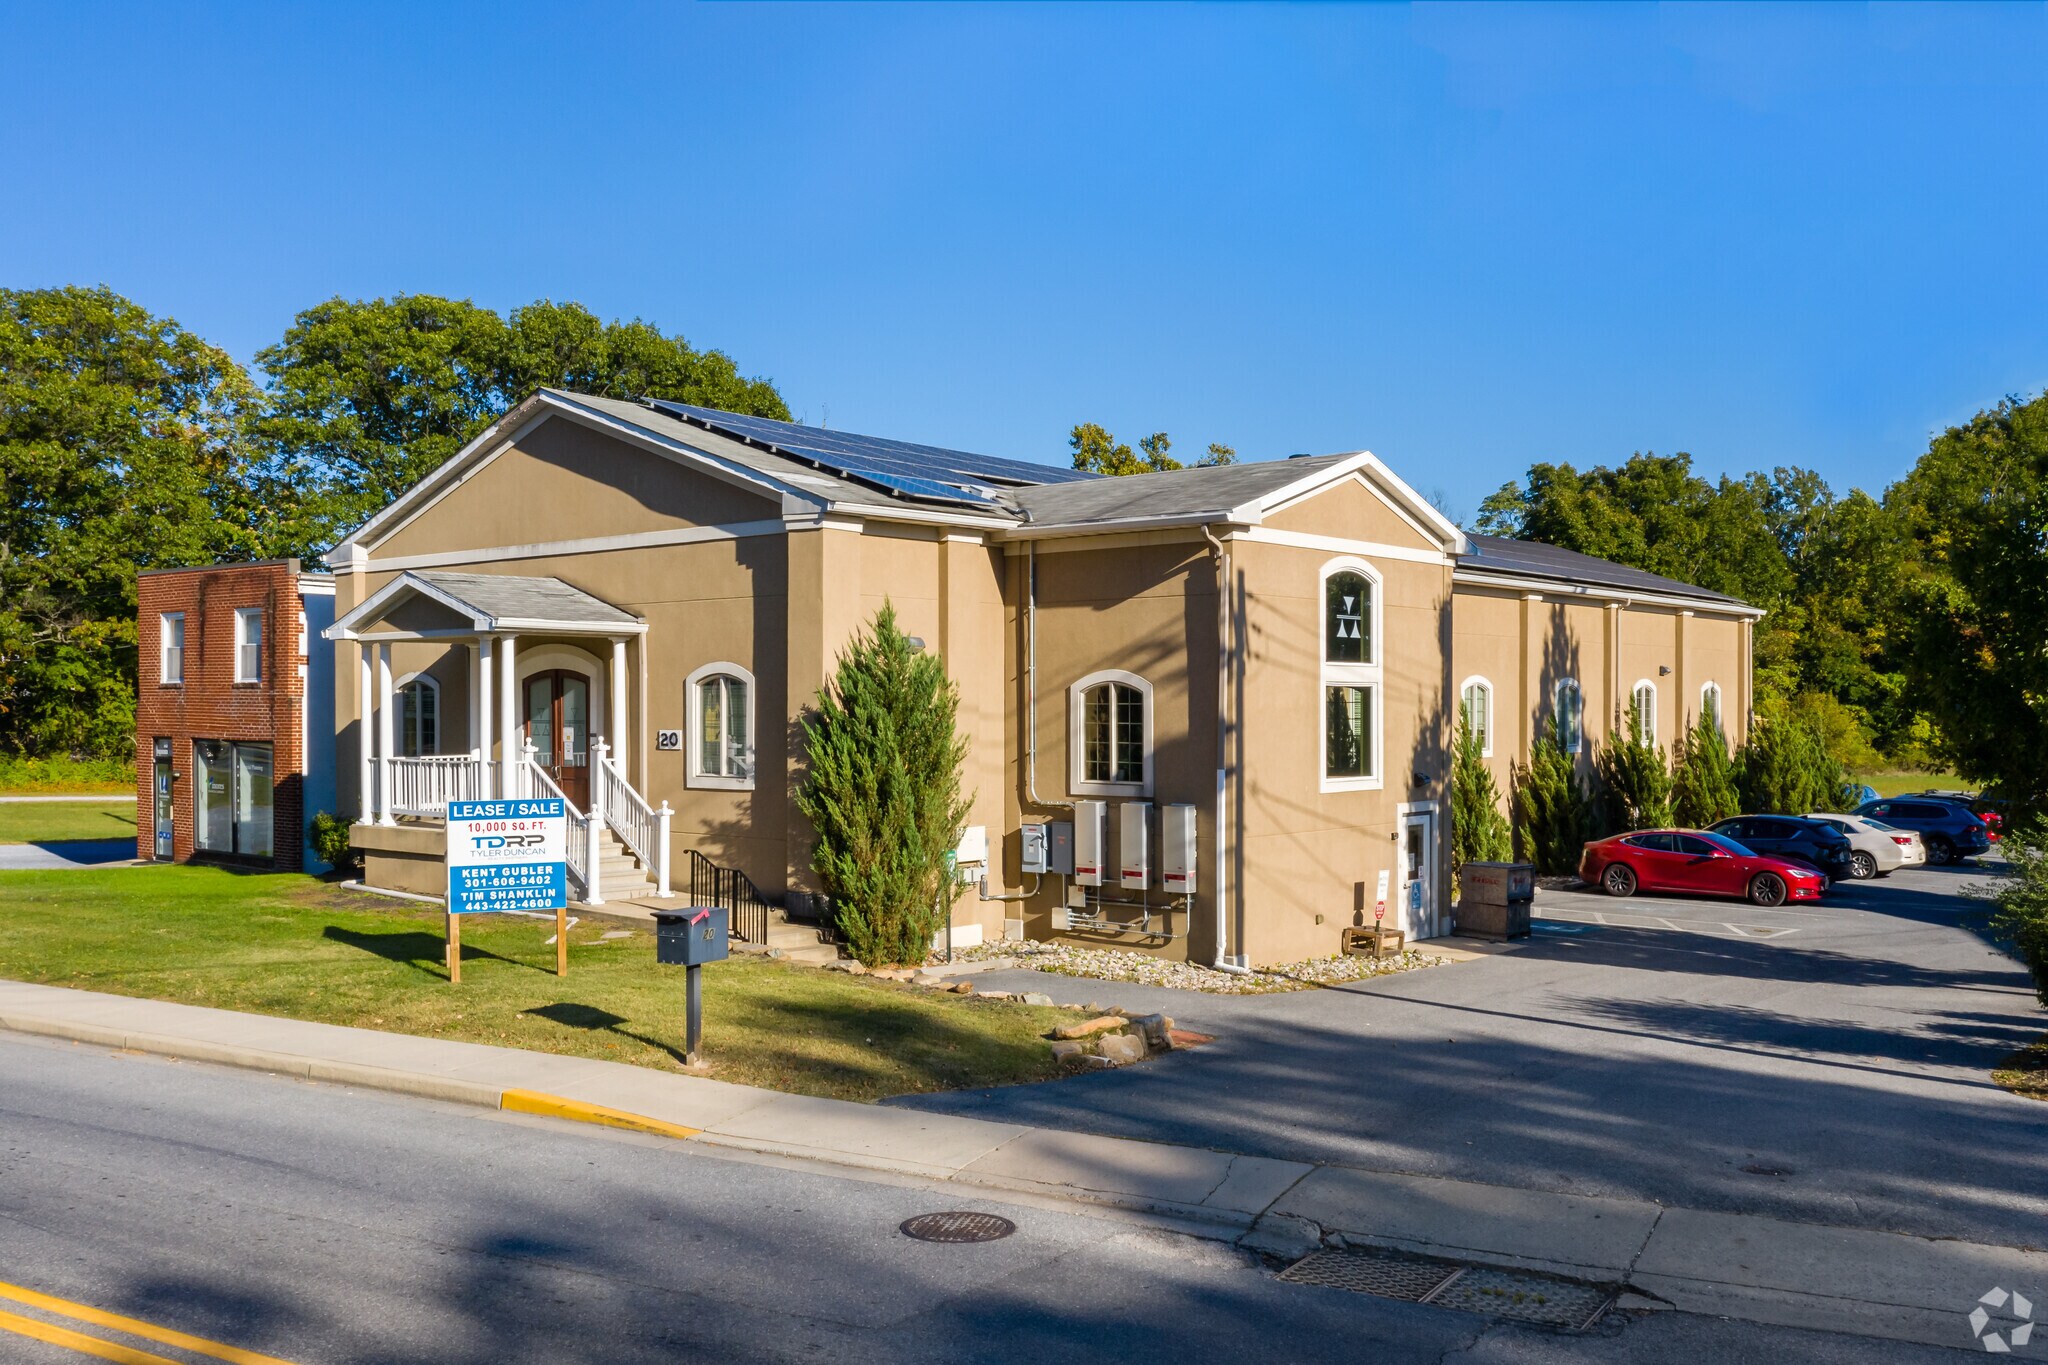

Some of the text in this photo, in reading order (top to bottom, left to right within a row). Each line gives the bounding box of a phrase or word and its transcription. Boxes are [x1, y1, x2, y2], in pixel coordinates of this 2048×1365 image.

[660, 732, 678, 747] 20
[453, 802, 560, 817] LEASE / SALE
[468, 821, 547, 834] 10,000 SQ. FT.
[471, 834, 545, 849] TDRP
[470, 848, 546, 858] TYLER DUNCAN
[462, 866, 553, 878] KENT GUBLER
[465, 876, 551, 888] 301-606-9402
[460, 888, 556, 901] TIM SHANKLIN
[465, 899, 552, 911] 443-422-4600
